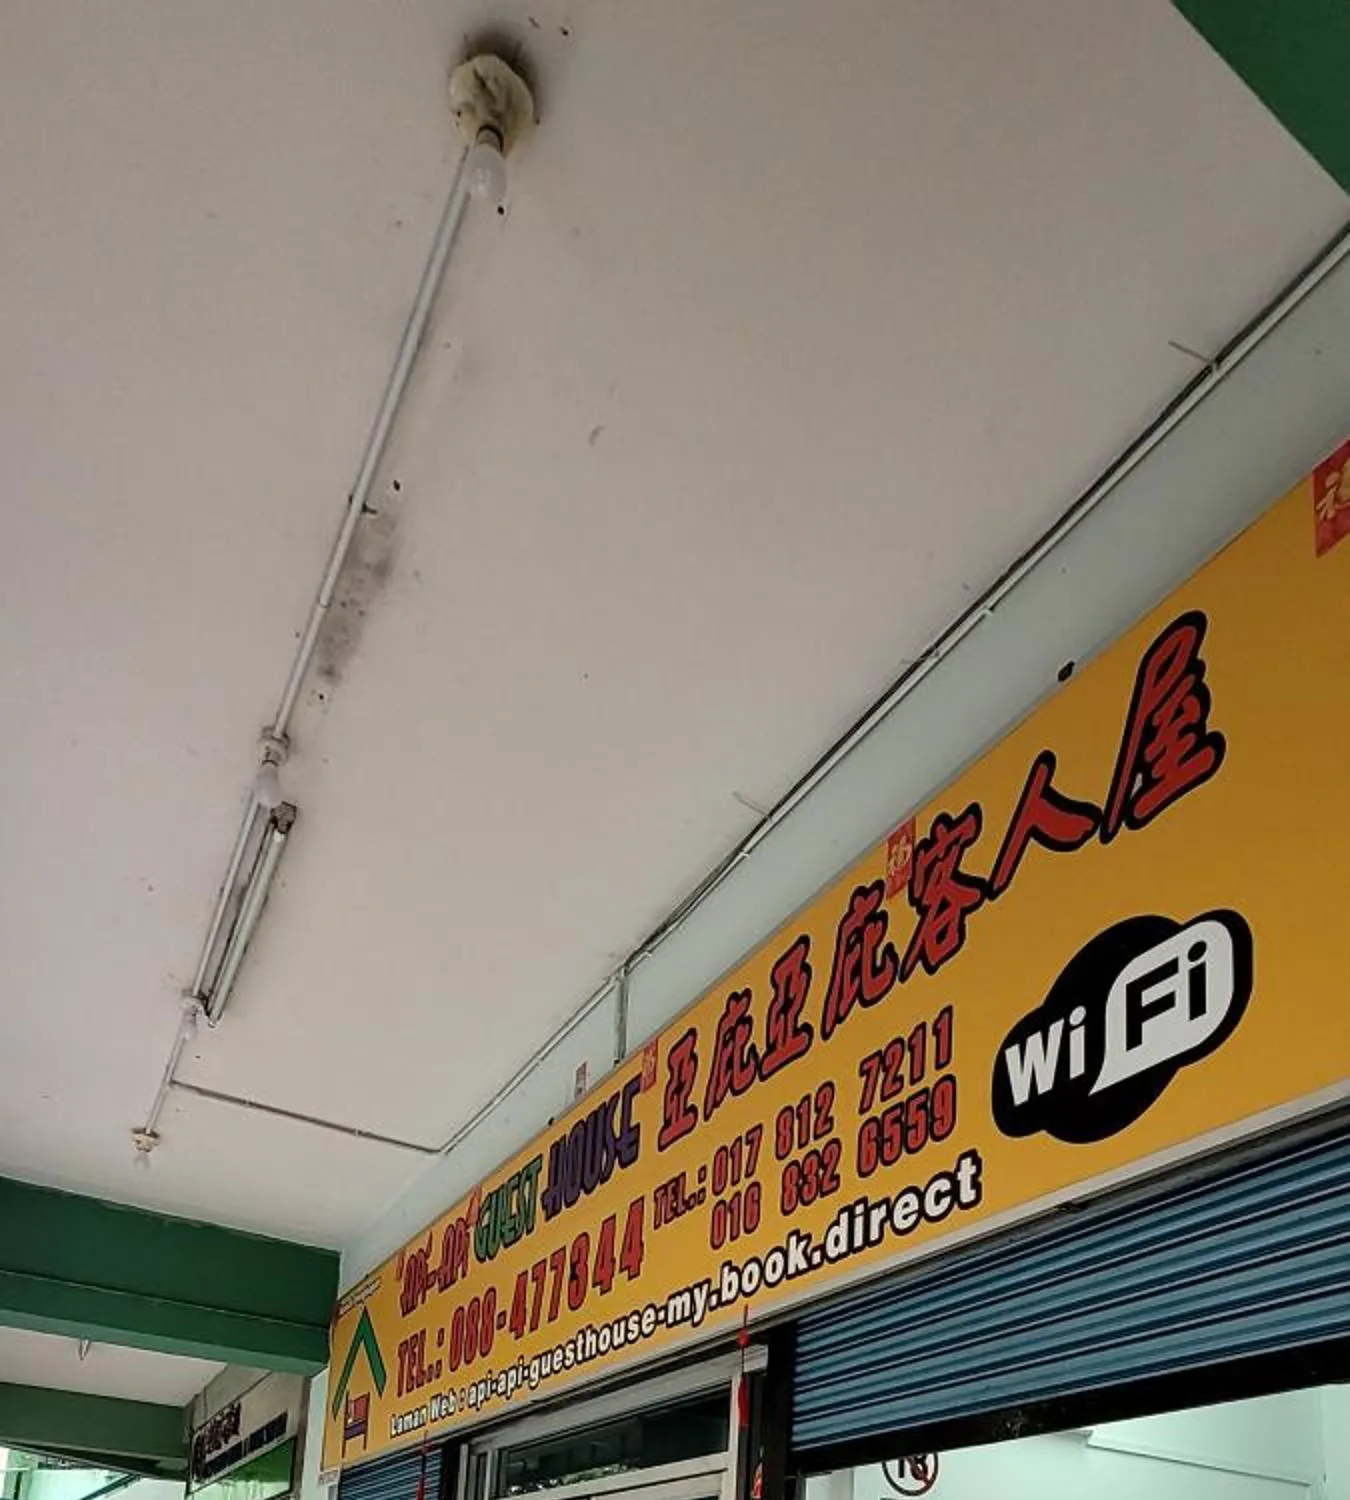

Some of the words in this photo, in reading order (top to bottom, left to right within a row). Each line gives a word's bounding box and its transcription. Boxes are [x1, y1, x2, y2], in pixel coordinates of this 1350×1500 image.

[474, 1154, 542, 1262] GUEST
[541, 1073, 642, 1222] HOUSE
[710, 1181, 761, 1250] 016
[781, 1137, 841, 1216] 832
[857, 1074, 957, 1178] 6559
[711, 1123, 763, 1196] 017
[775, 1081, 835, 1160] 812
[858, 1005, 954, 1115] 7211
[449, 1196, 645, 1372] 088-477344
[390, 1402, 429, 1438] Laman
